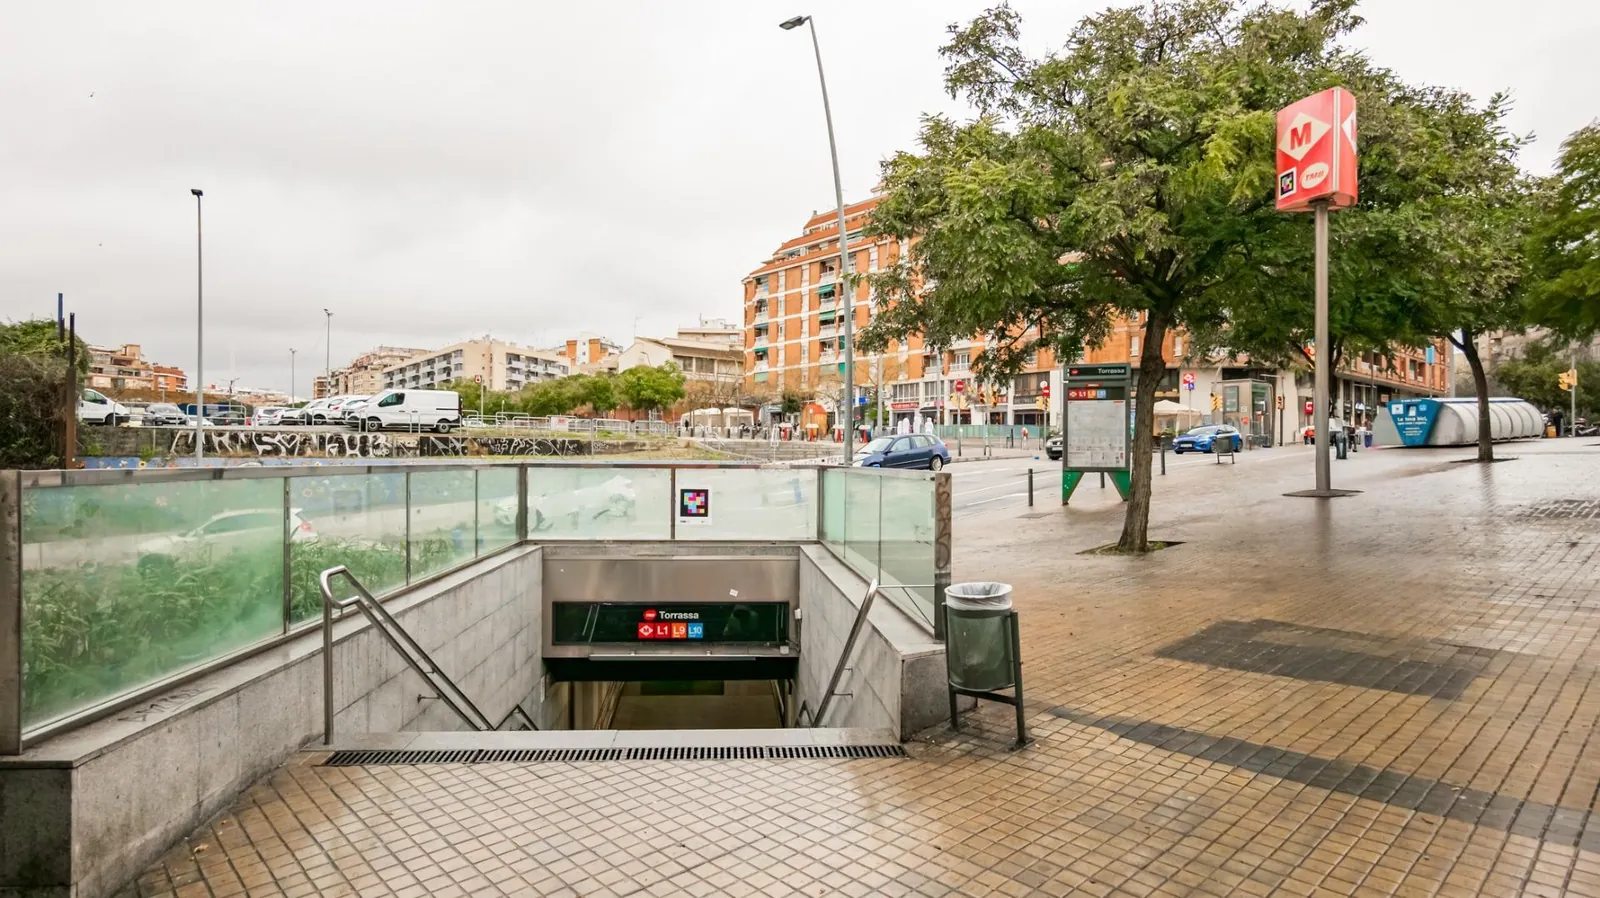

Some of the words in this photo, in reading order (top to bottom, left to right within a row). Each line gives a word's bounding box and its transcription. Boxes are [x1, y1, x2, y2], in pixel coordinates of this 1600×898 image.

[1290, 122, 1312, 150] M
[659, 611, 699, 619] Torrassa
[657, 626, 668, 635] L1
[673, 626, 686, 634] L9
[688, 626, 702, 634] L10
